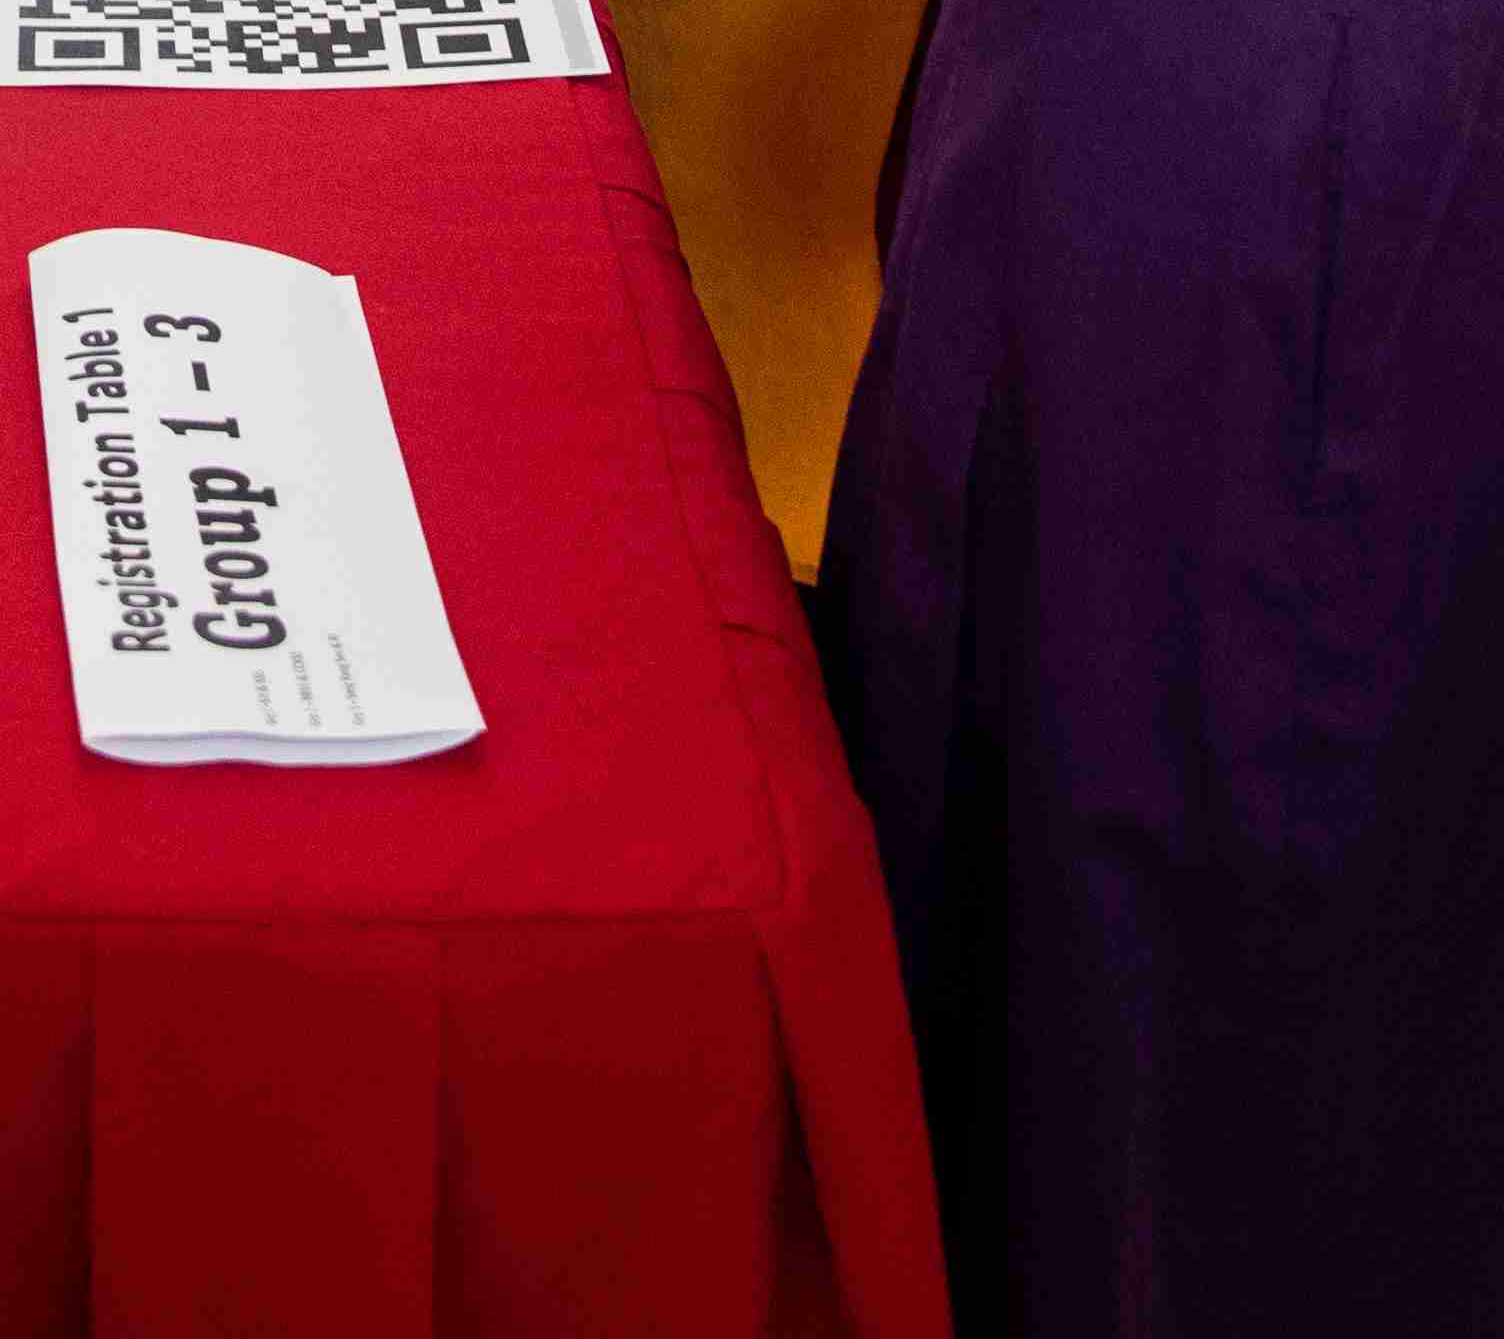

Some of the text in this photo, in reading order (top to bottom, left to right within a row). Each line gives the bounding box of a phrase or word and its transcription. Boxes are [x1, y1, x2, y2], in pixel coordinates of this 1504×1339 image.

[142, 313, 222, 343] 3
[60, 306, 180, 653] Registration Table 1
[159, 417, 241, 439] 1
[188, 466, 288, 650] Group
